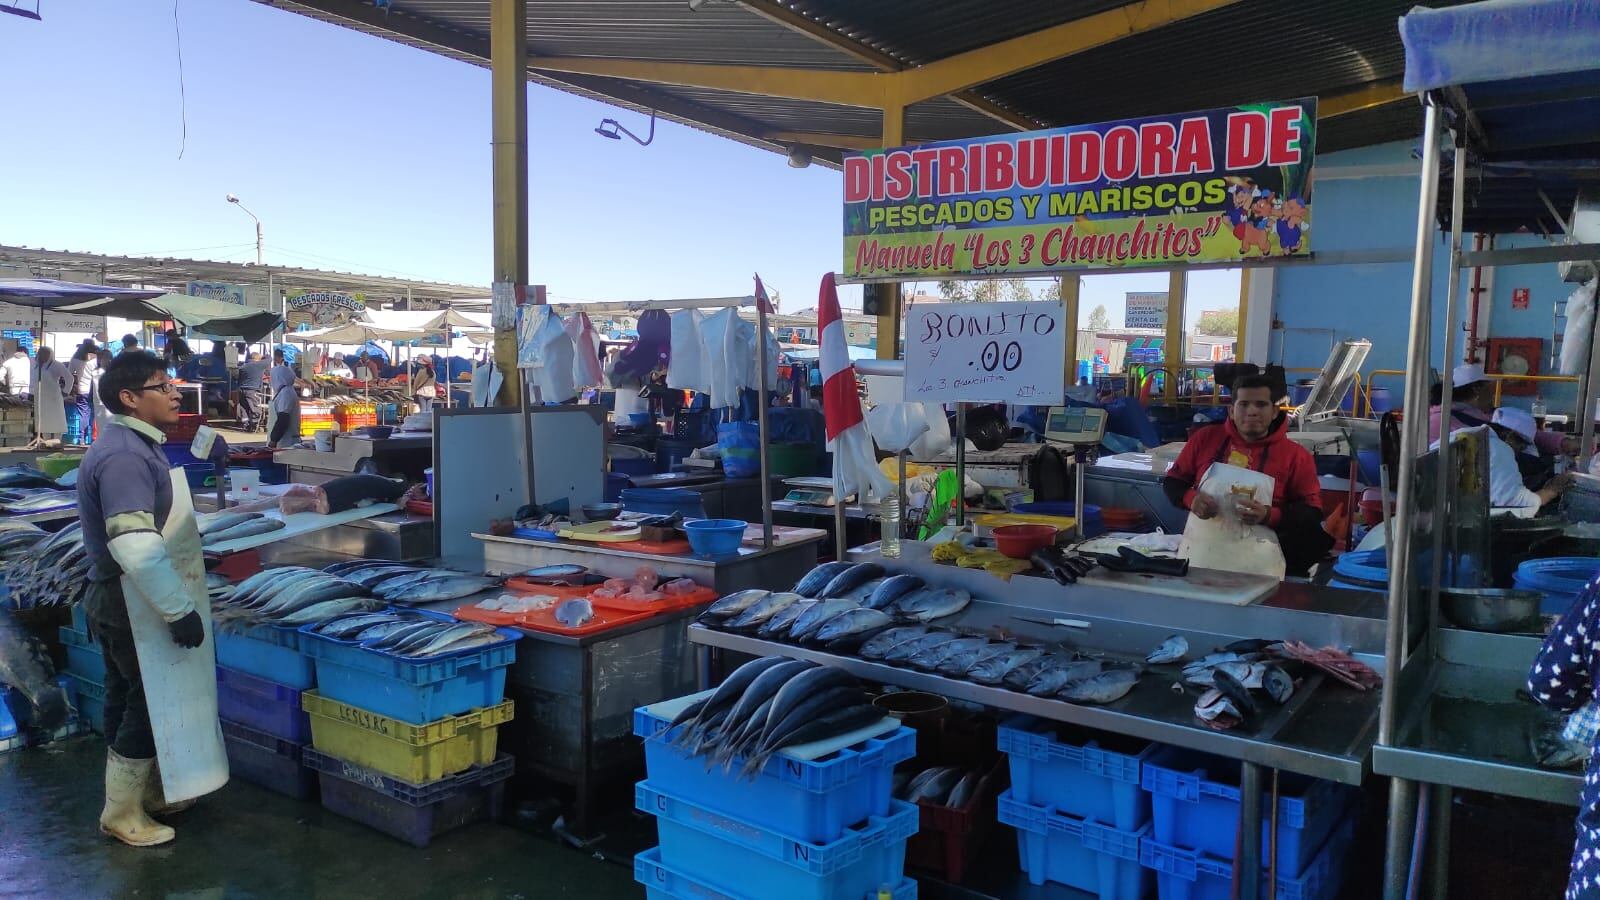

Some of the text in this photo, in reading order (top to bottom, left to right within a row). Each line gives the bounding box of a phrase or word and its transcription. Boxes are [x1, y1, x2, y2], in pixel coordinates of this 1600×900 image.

[843, 105, 1303, 204] DISTRIBUIDORA DE
[868, 178, 1226, 230] PESCADOS Y MARISCOS
[854, 237, 956, 274] Manuela
[1018, 239, 1032, 264] 3
[291, 293, 366, 312] PESCADOS FRESCOS
[920, 305, 1056, 344] BONITO
